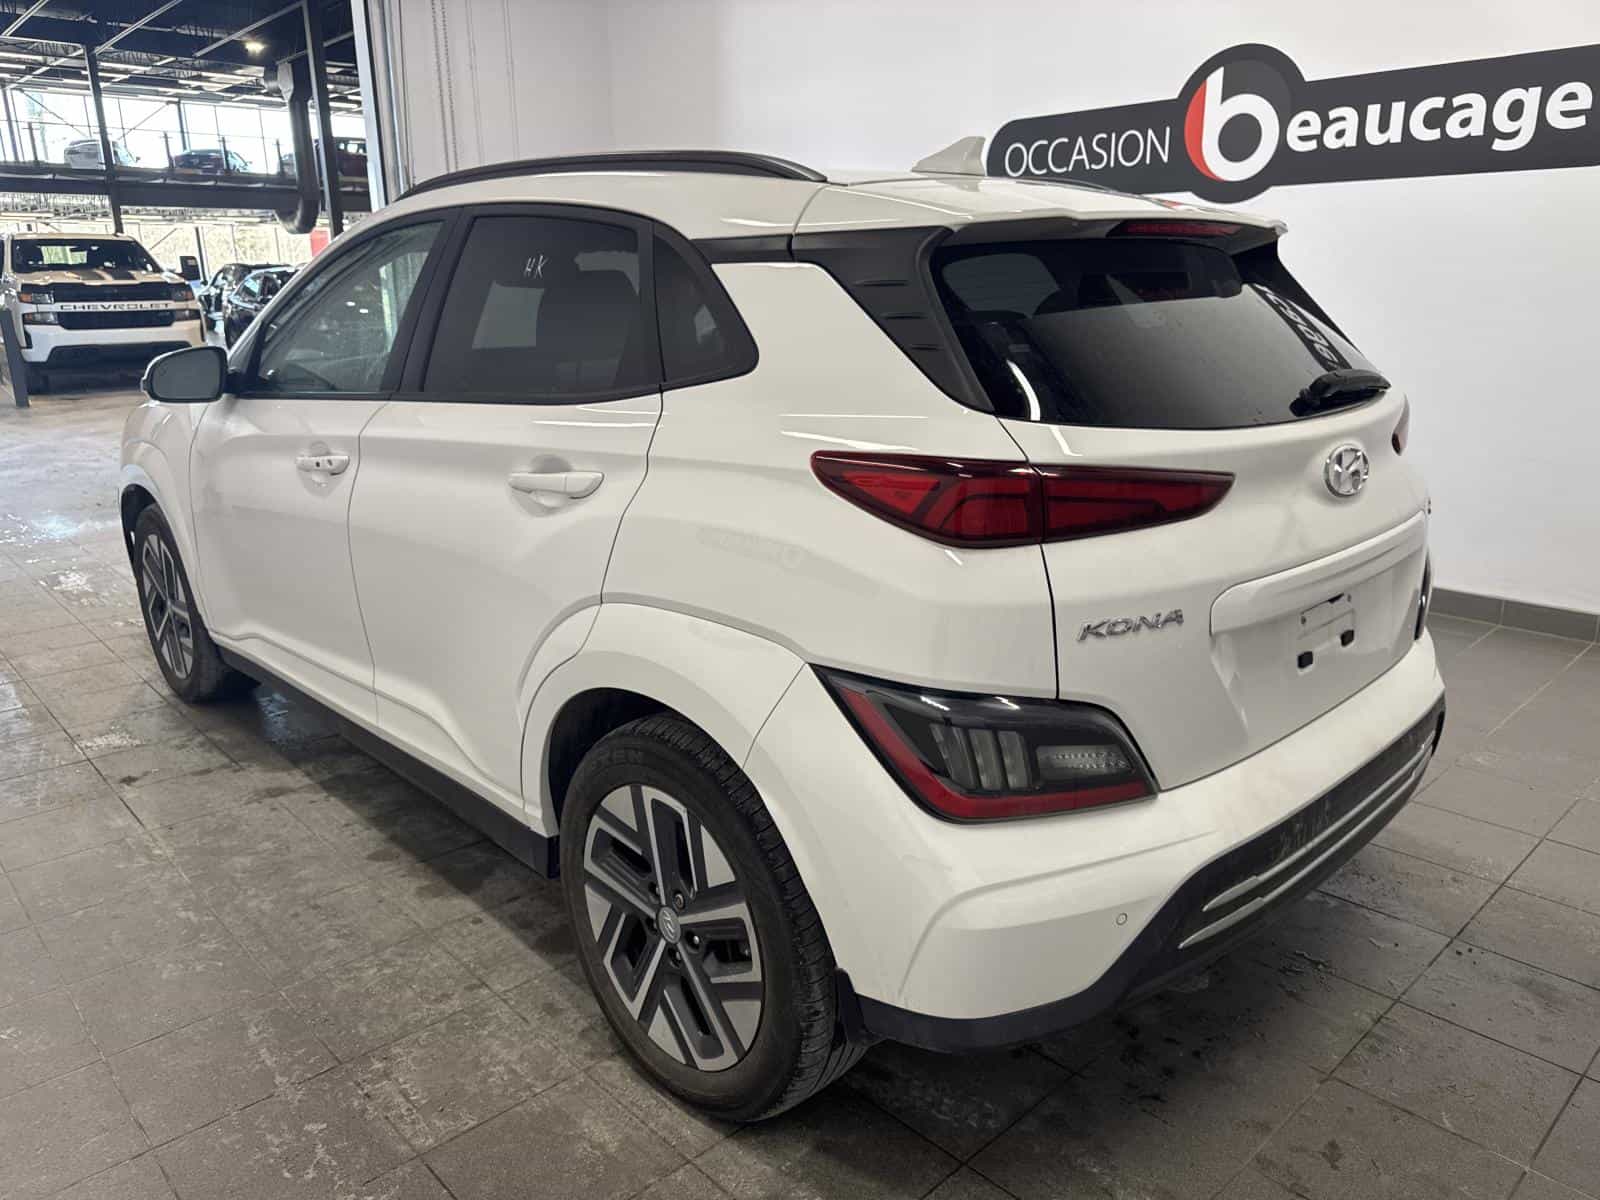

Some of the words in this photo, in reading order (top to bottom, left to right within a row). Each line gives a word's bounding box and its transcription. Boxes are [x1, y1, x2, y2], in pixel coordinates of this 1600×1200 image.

[1004, 126, 1170, 178] OCCASION
[60, 302, 170, 311] CHEVROLET
[1078, 608, 1184, 642] KONA
